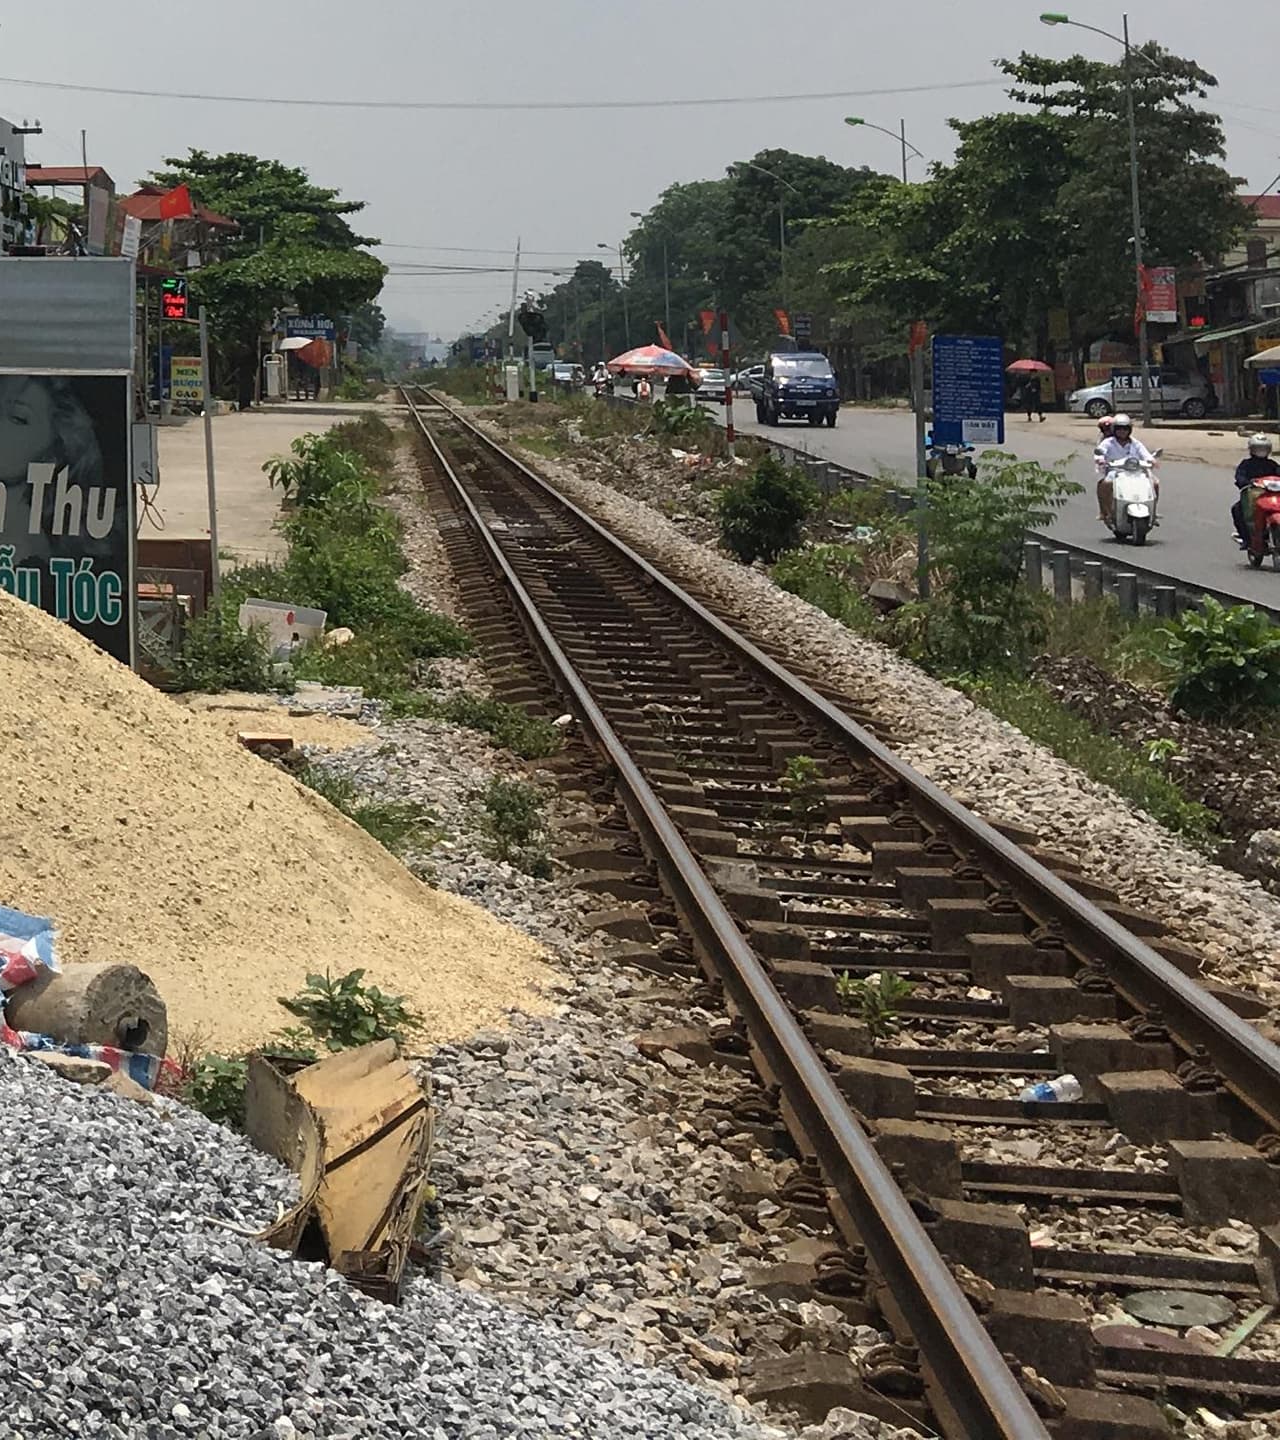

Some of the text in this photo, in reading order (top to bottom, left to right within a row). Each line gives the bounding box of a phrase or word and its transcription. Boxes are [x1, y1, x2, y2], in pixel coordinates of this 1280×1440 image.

[1112, 375, 1129, 388] XE
[26, 462, 117, 540] Thu
[50, 557, 123, 626] Tóc
